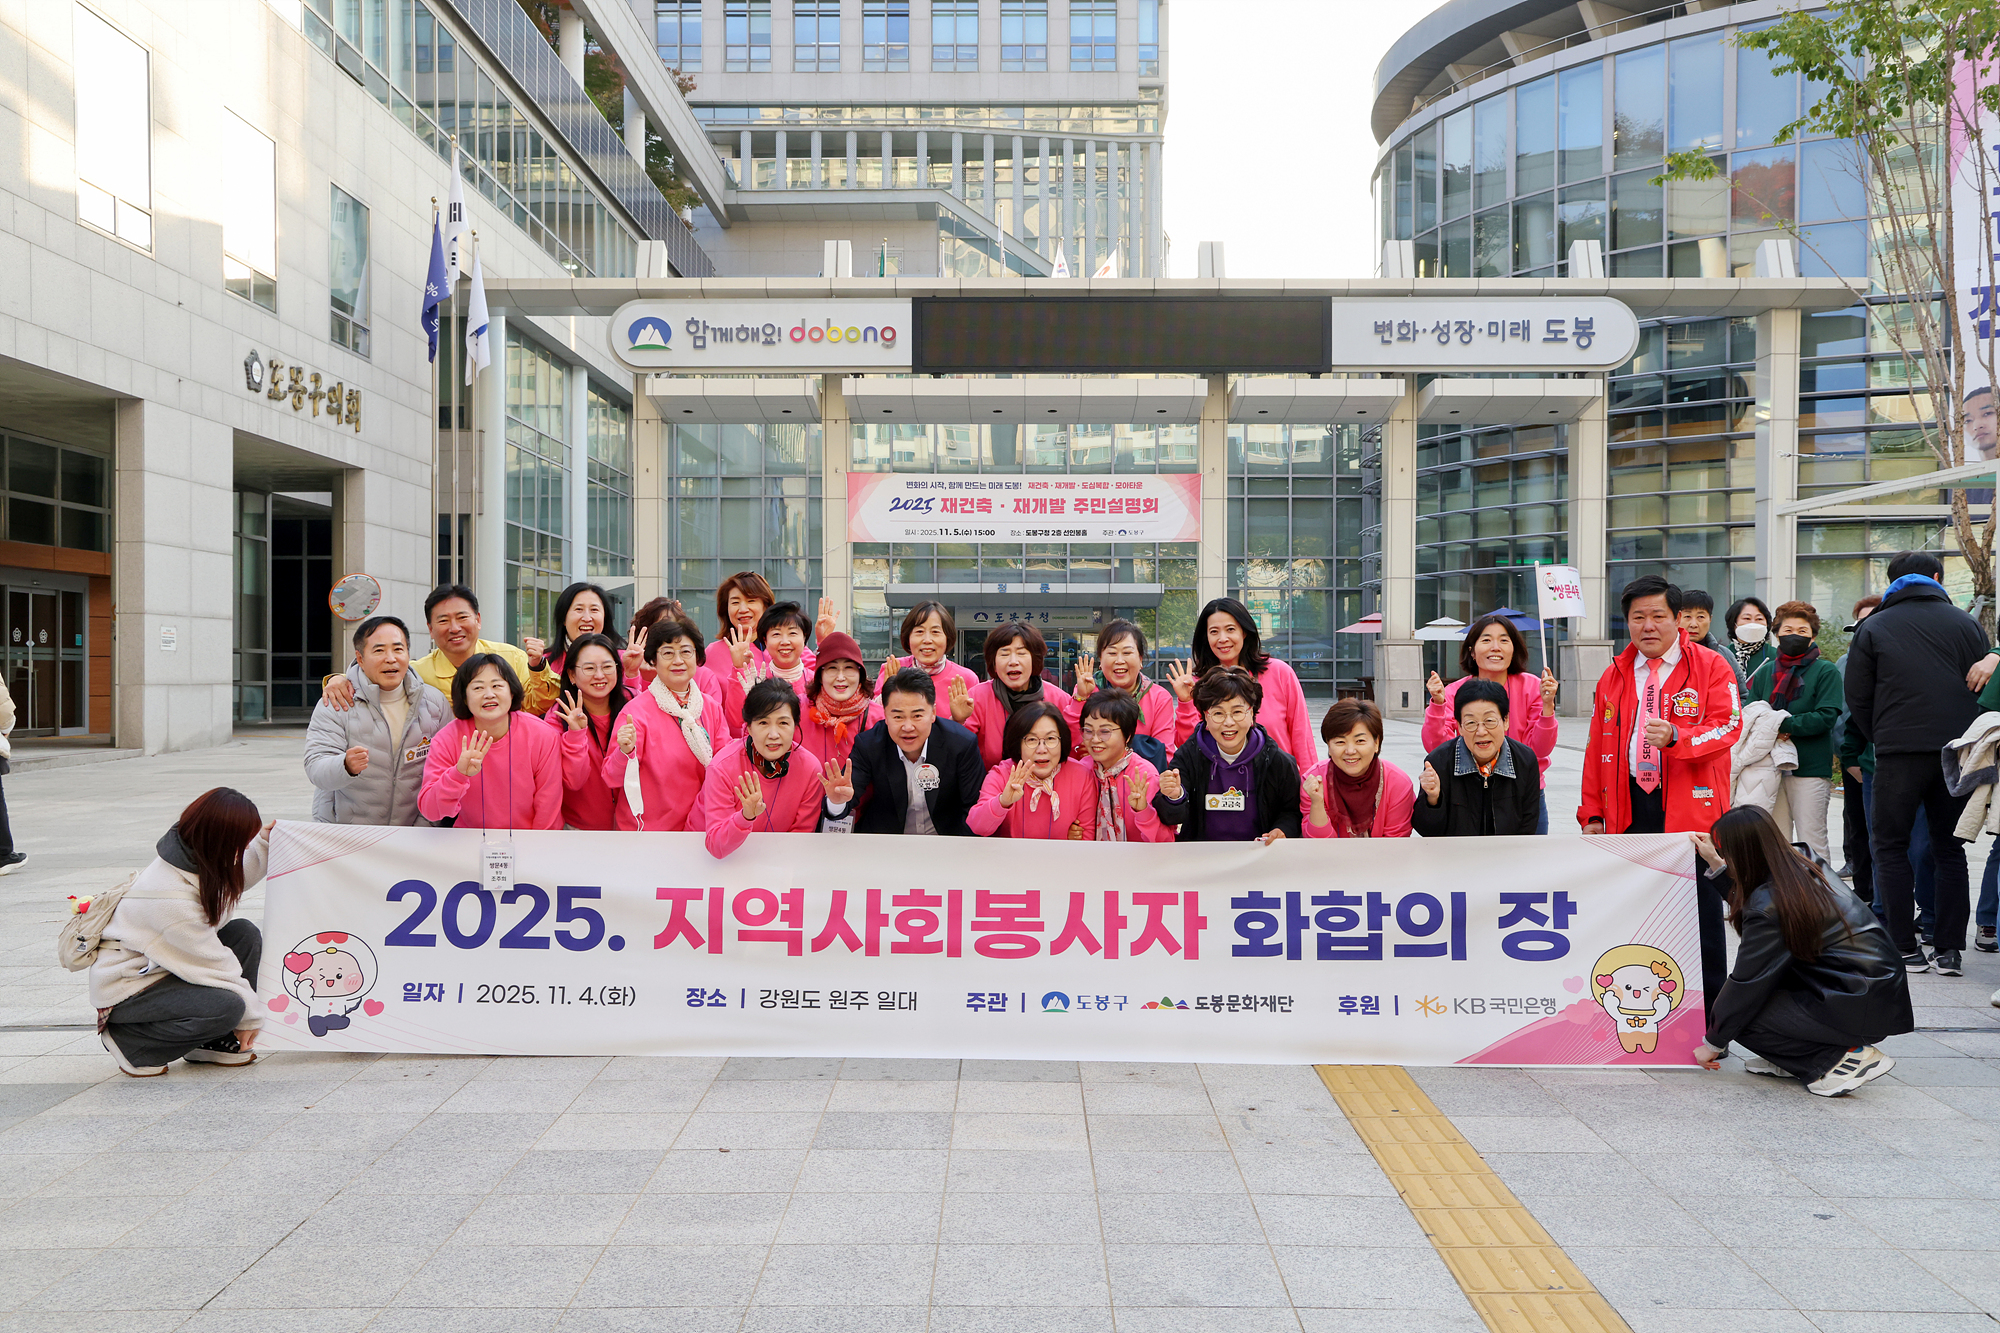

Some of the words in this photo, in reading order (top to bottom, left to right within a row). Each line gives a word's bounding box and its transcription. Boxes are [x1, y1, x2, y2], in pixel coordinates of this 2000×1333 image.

[686, 317, 782, 349] 함께해요!
[789, 318, 897, 349] dobong
[1542, 317, 1596, 349] 도봉
[267, 359, 361, 433] 도봉구의회
[905, 481, 928, 490] 변화의
[930, 481, 947, 490] 시작,
[948, 481, 963, 490] 함께
[965, 481, 987, 490] 만드는
[988, 481, 1003, 490] 미래
[1004, 481, 1022, 490] 도봉!
[1027, 481, 1049, 490] 재건축
[1055, 481, 1076, 490] 재개발
[1115, 481, 1143, 490] 모아타운
[888, 496, 936, 515] 2025
[940, 498, 993, 514] 재건축
[1012, 498, 1067, 515] 재개발
[1073, 498, 1159, 515] 주민설명회
[1025, 529, 1050, 537] 도봉구청
[1646, 684, 1655, 713] ARENA
[384, 879, 626, 952] 2025.
[653, 886, 1207, 960] 지역사회봉사자
[1230, 890, 1467, 961] 화합의
[1498, 891, 1578, 962] 장
[402, 982, 445, 1003] 일자
[476, 984, 540, 1005] 2025.
[548, 985, 572, 1005] 11.
[578, 985, 637, 1007] 4.(화)
[686, 987, 728, 1008] 장소
[759, 989, 821, 1010] 강원도
[828, 990, 870, 1011] 원주
[877, 991, 918, 1012] 일대
[966, 992, 1008, 1013] 주관
[1076, 994, 1129, 1012] 도봉구
[1194, 994, 1294, 1014] 도봉문화재단
[1338, 995, 1381, 1016] 후원
